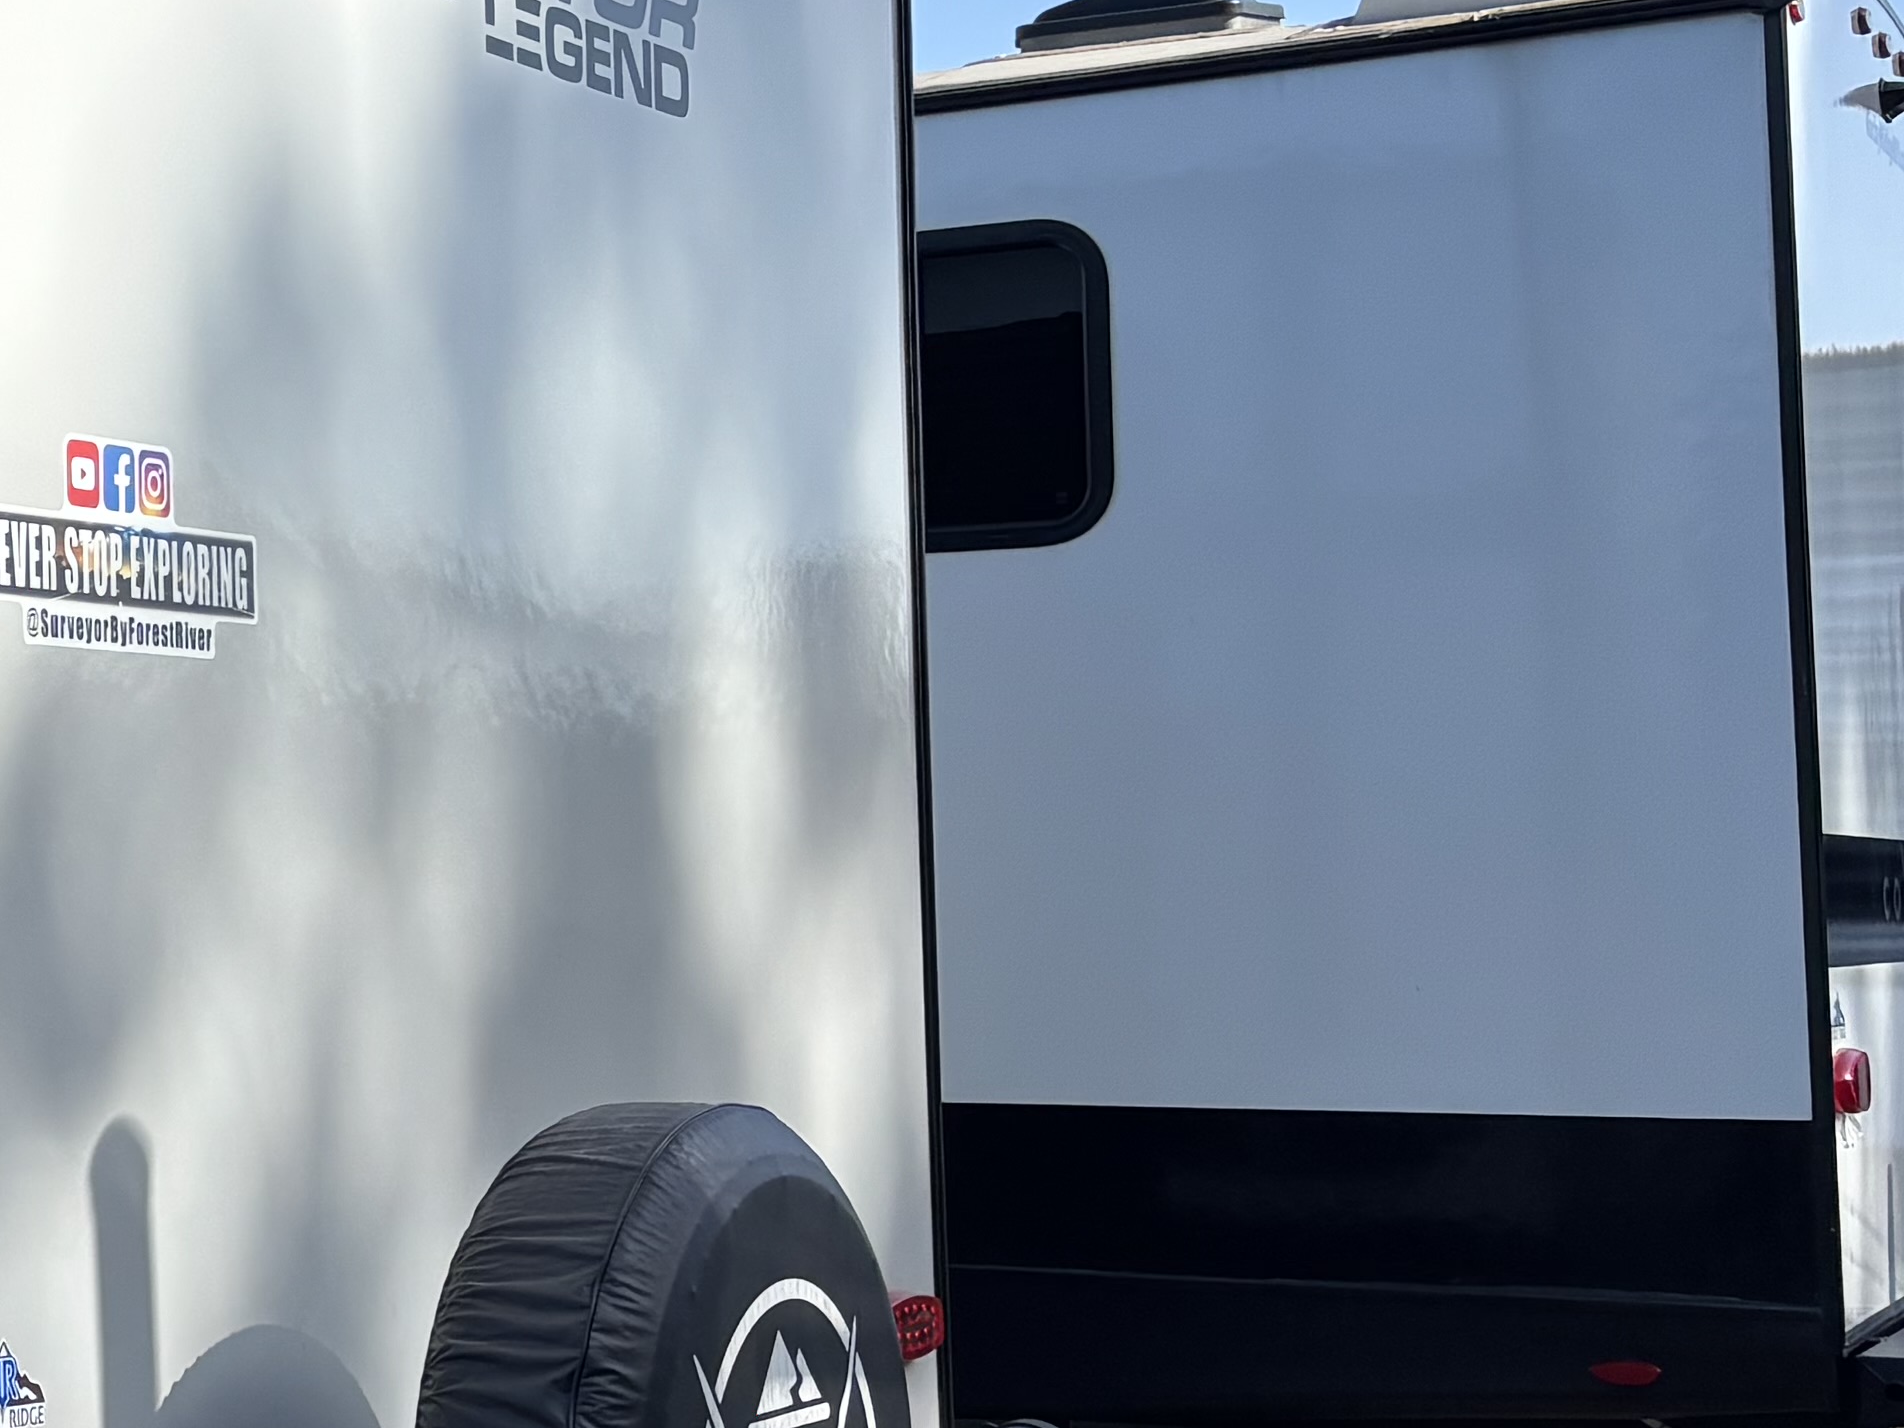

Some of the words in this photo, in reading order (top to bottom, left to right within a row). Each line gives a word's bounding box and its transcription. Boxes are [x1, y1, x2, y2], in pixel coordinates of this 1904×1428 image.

[63, 526, 123, 597] STOP
[130, 535, 248, 610] EXPLORING
[26, 607, 212, 651] @SurveyorByForestRiver
[9, 1405, 44, 1428] RIDGE
